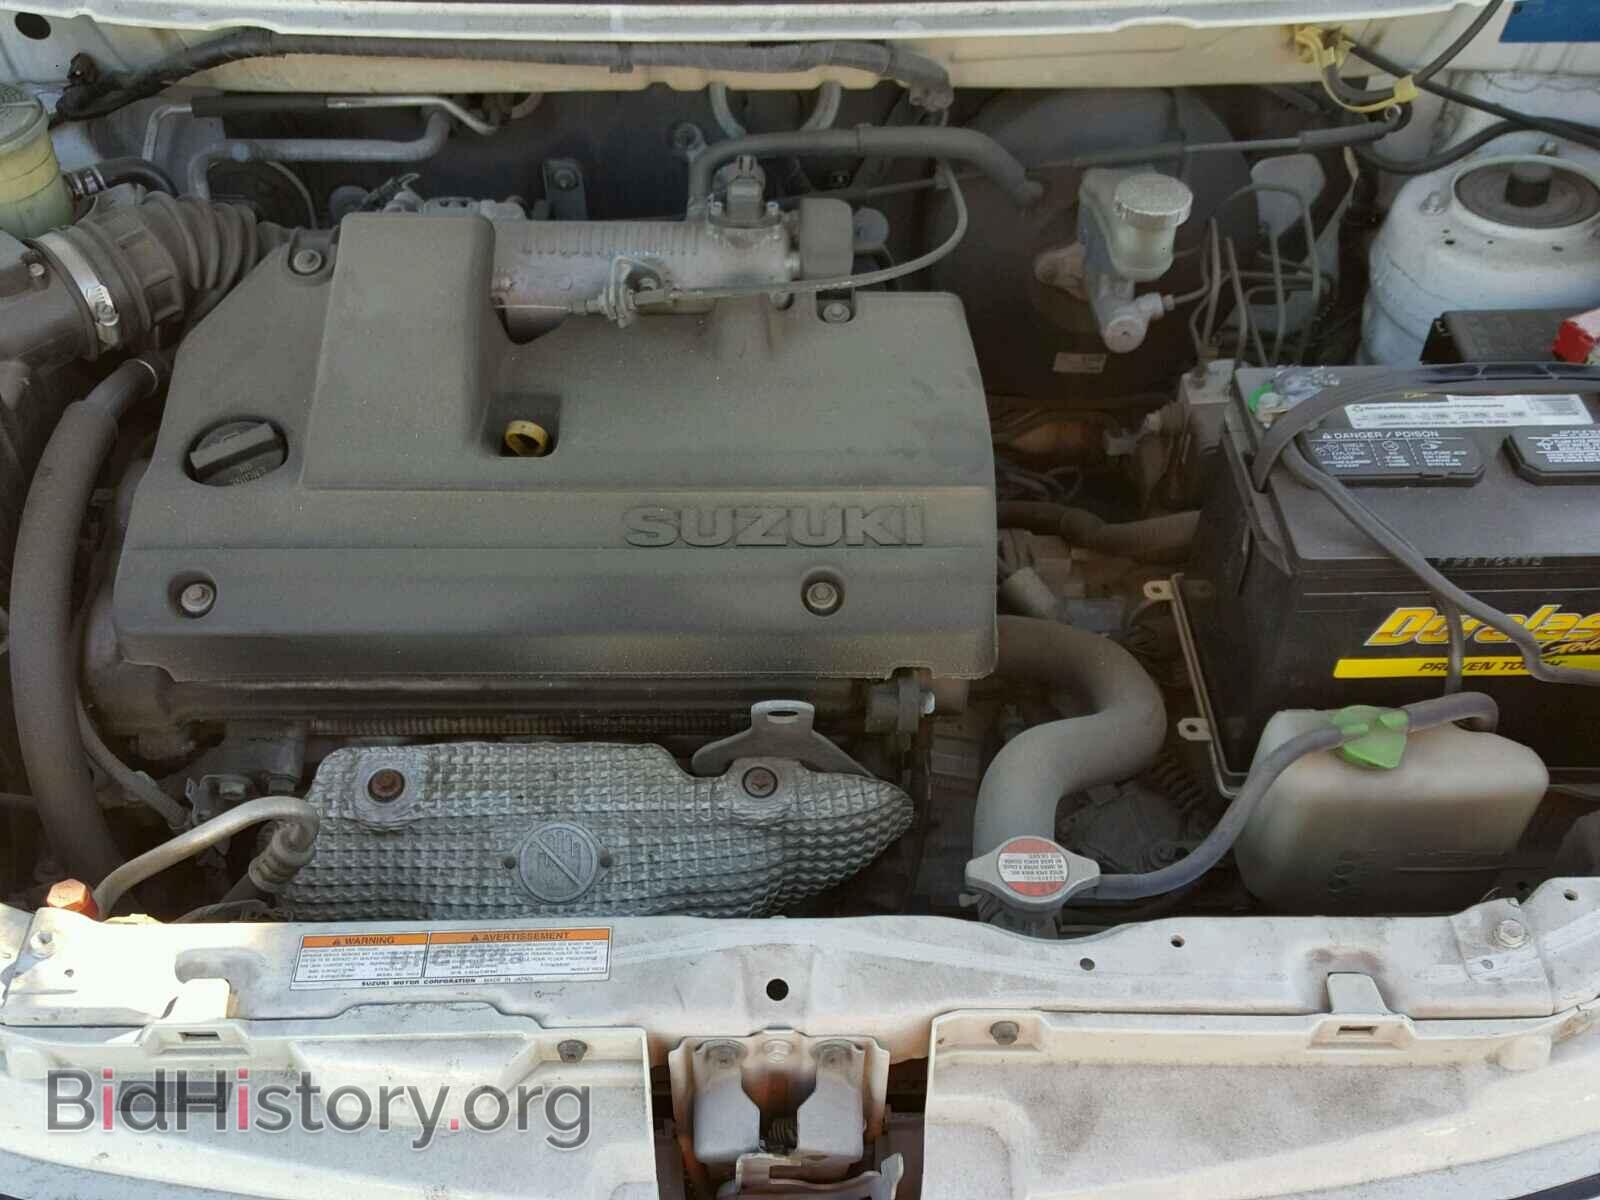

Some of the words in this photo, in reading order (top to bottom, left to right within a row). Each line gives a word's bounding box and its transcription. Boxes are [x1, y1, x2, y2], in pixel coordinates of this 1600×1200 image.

[1334, 431, 1383, 439] DANGER
[1394, 430, 1439, 438] POISON
[622, 504, 925, 547] SUZUKI
[344, 935, 395, 945] WARNING
[482, 931, 571, 942] AVERTISSEMENT
